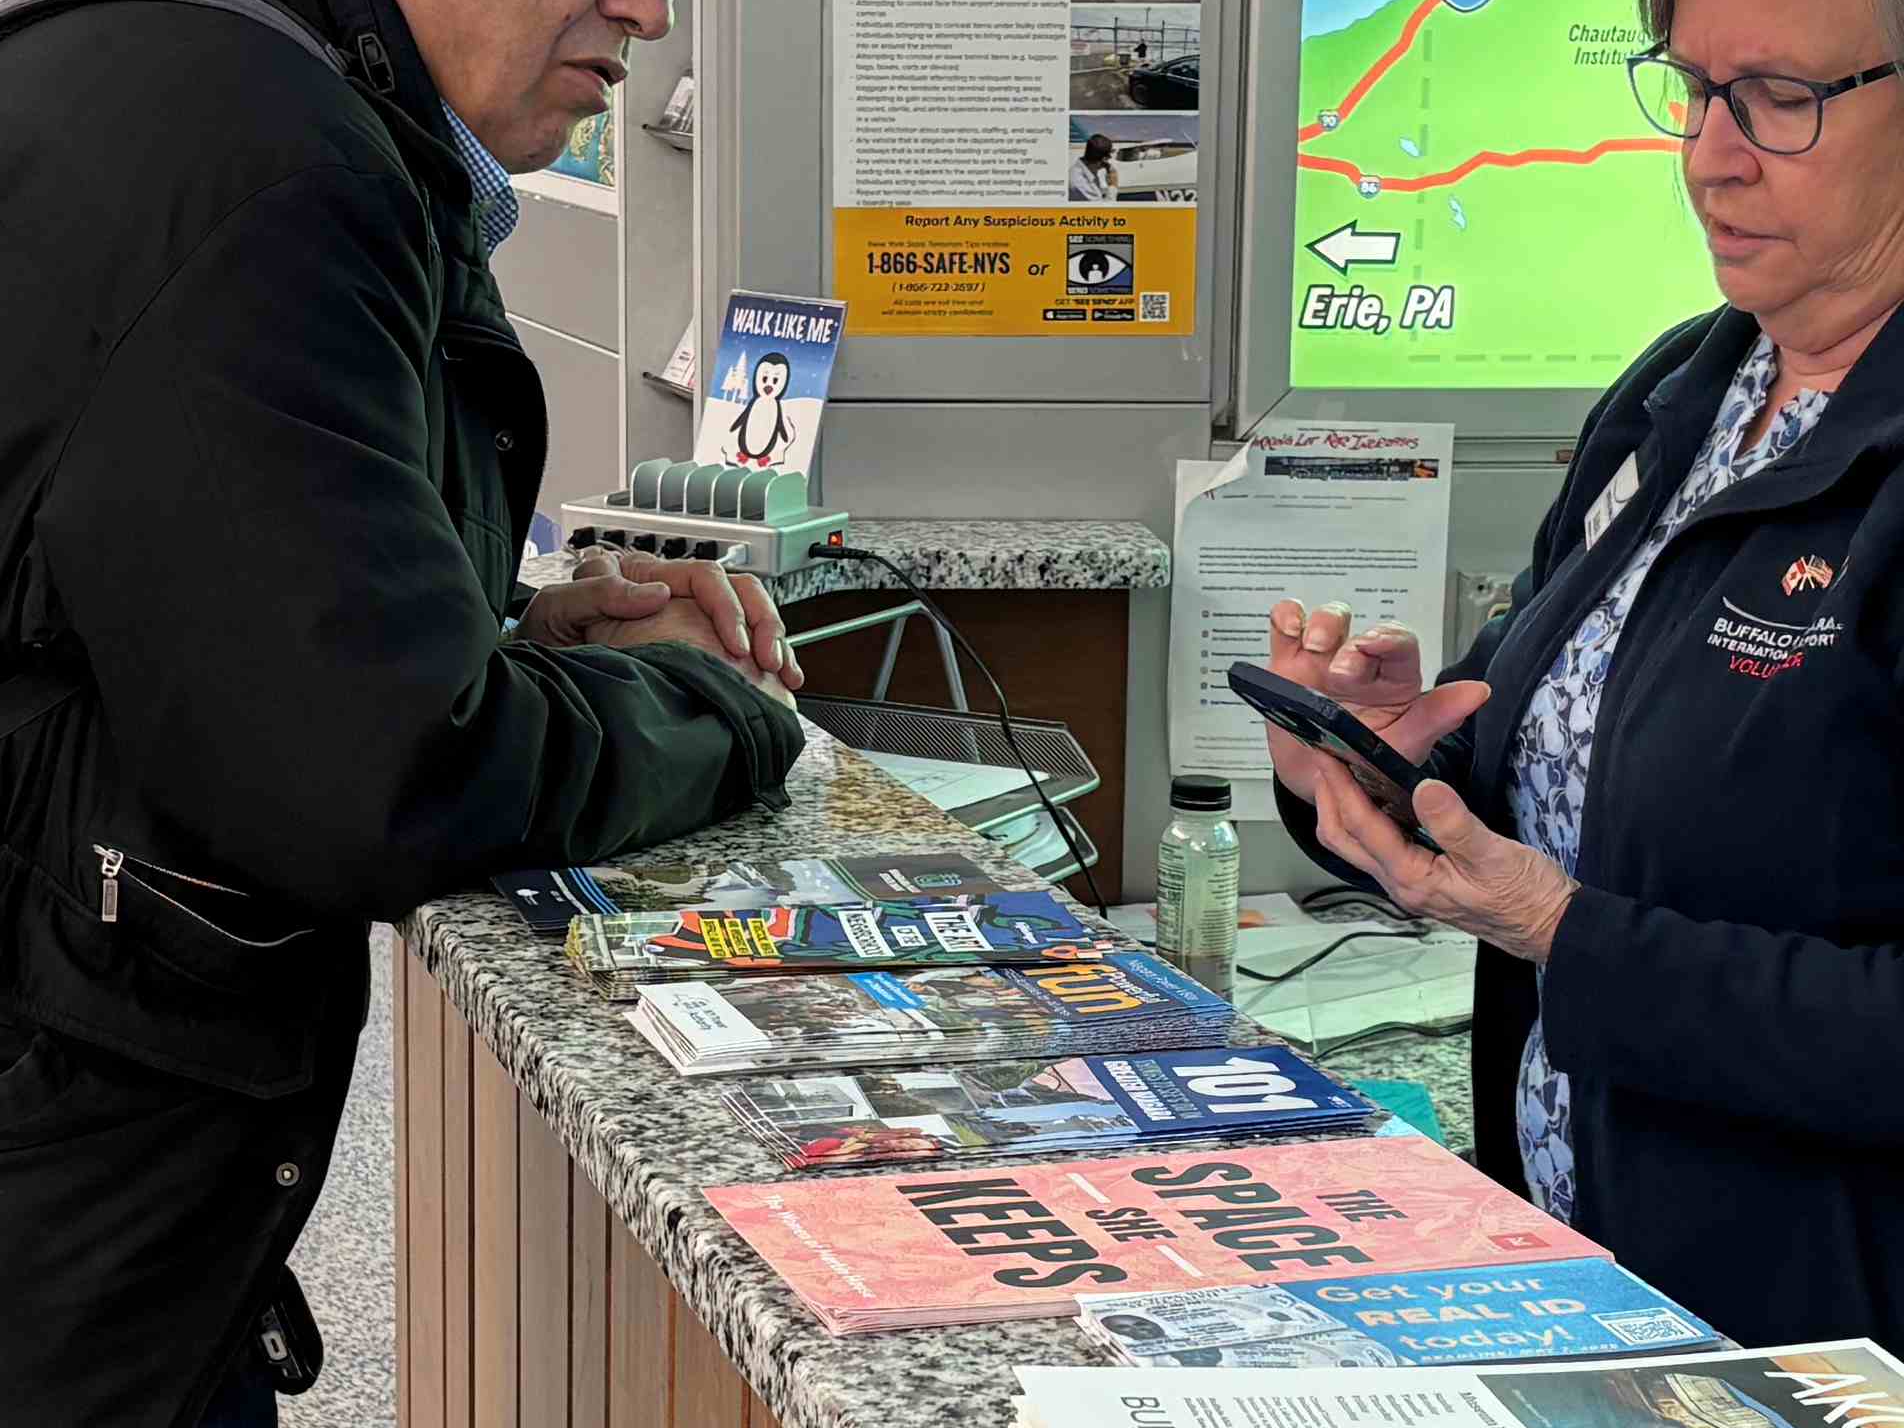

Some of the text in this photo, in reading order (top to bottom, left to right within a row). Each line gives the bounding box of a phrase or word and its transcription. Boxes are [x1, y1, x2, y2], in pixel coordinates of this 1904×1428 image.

[905, 215, 1126, 228] Report Any Suspicious Activity to
[867, 252, 1049, 276] 1-866-SAFE-NYS or
[732, 305, 834, 344] WALK LIKE ME
[1299, 285, 1456, 334] Erie, PA
[1713, 617, 1794, 648] BUFFALO
[1172, 1056, 1319, 1114] 101
[1084, 1205, 1179, 1243] SHE
[1131, 1161, 1375, 1273] SPACE
[1316, 1188, 1409, 1224] THE
[895, 1176, 1130, 1289] KEEPS
[1316, 1277, 1544, 1303] Get your
[1354, 1298, 1585, 1327] REAL ID
[1399, 1325, 1574, 1350] today!
